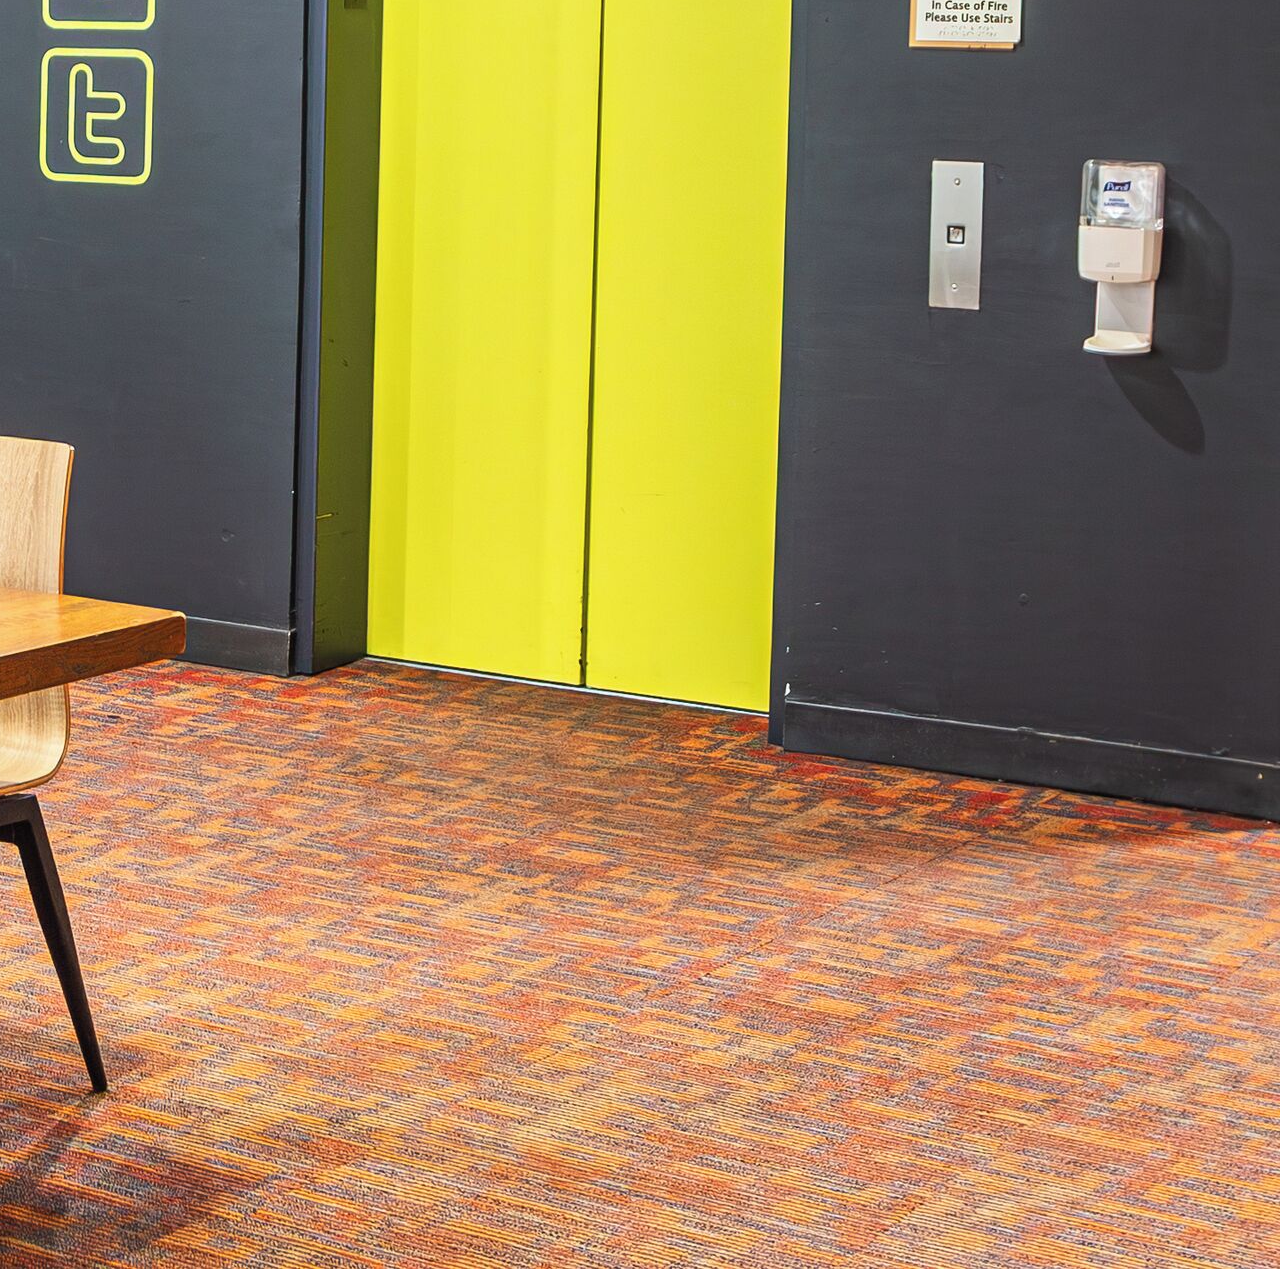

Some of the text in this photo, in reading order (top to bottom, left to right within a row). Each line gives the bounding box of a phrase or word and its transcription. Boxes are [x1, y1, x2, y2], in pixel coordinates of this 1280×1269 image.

[931, 0, 1008, 12] In Case of Fire
[925, 11, 1014, 24] Please Use Stairs
